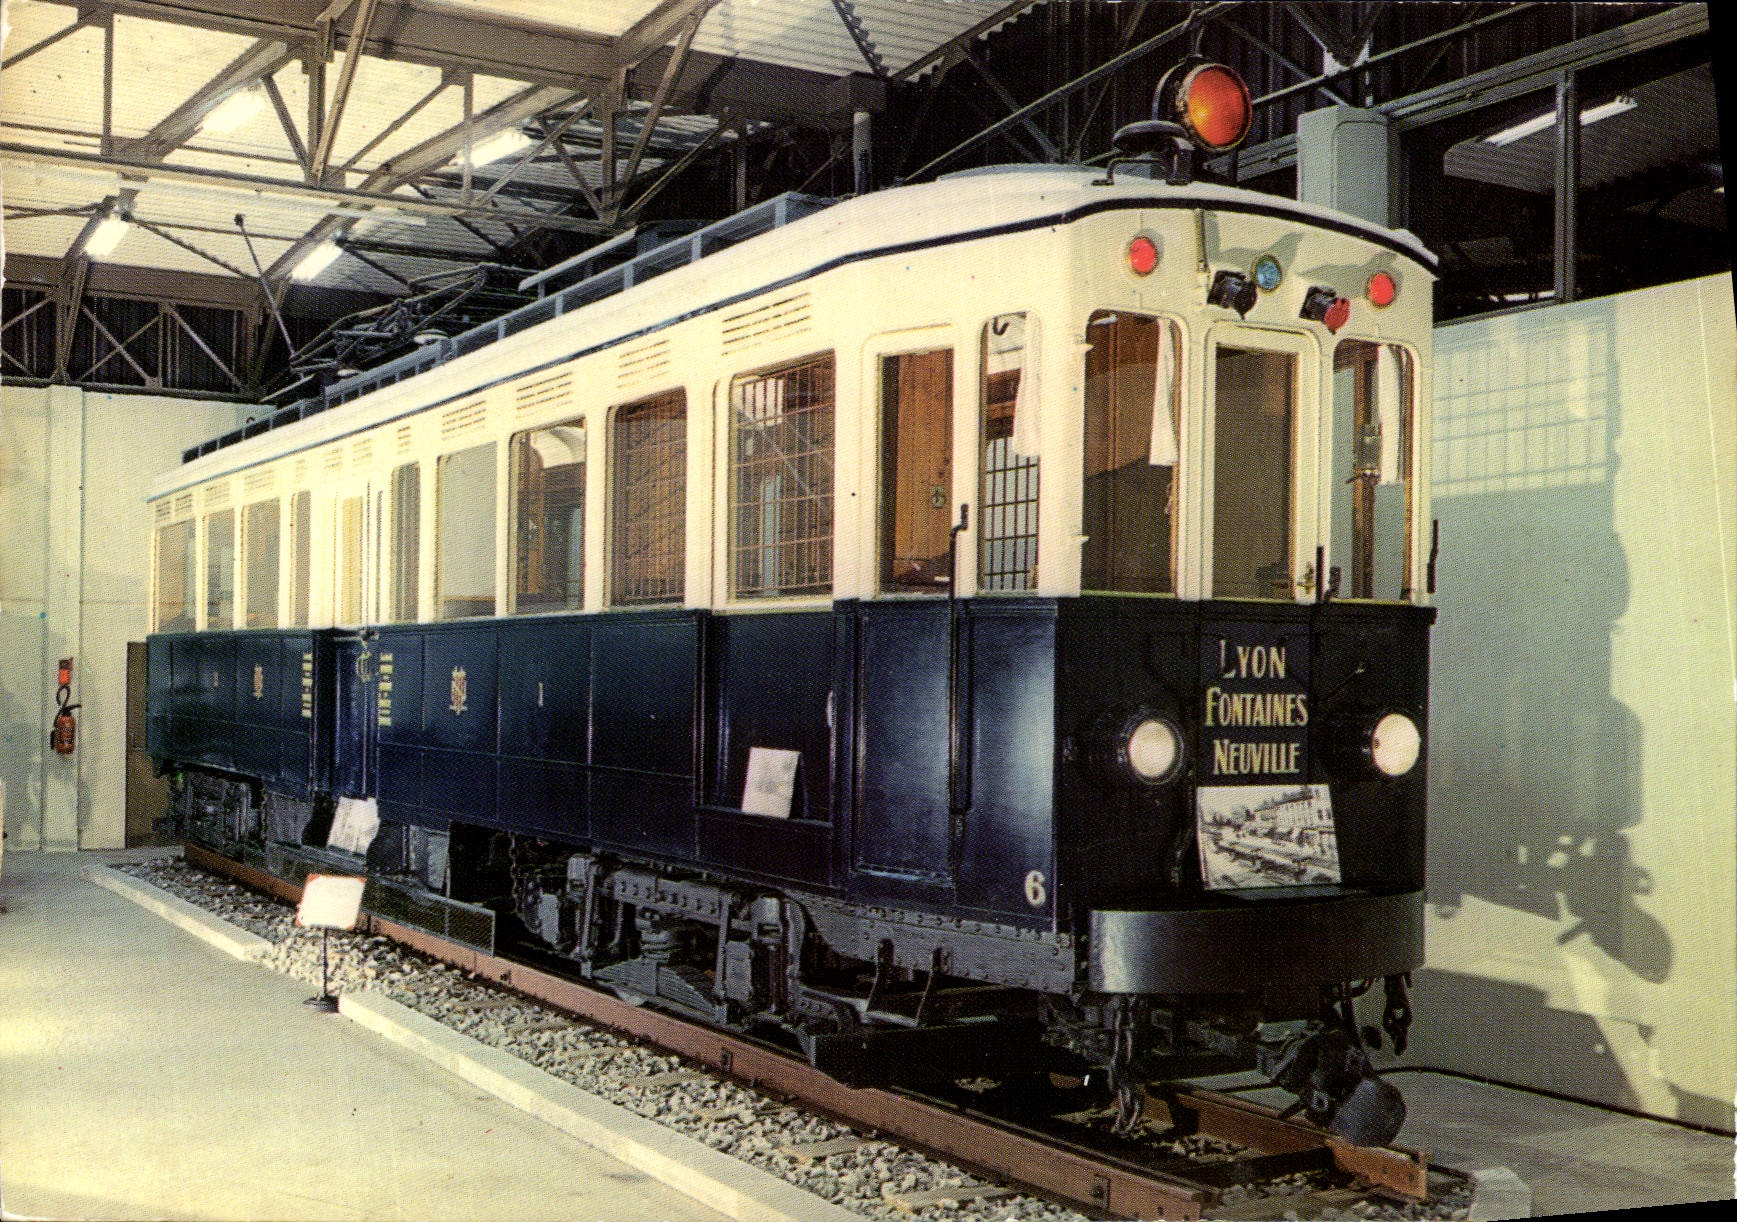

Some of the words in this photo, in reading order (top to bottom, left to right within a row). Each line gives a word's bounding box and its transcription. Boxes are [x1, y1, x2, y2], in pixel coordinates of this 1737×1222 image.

[1220, 639, 1286, 679] LYON
[1205, 687, 1308, 727] FONTAINES
[1213, 740, 1301, 775] NEUVILLE
[1024, 870, 1047, 906] 6
